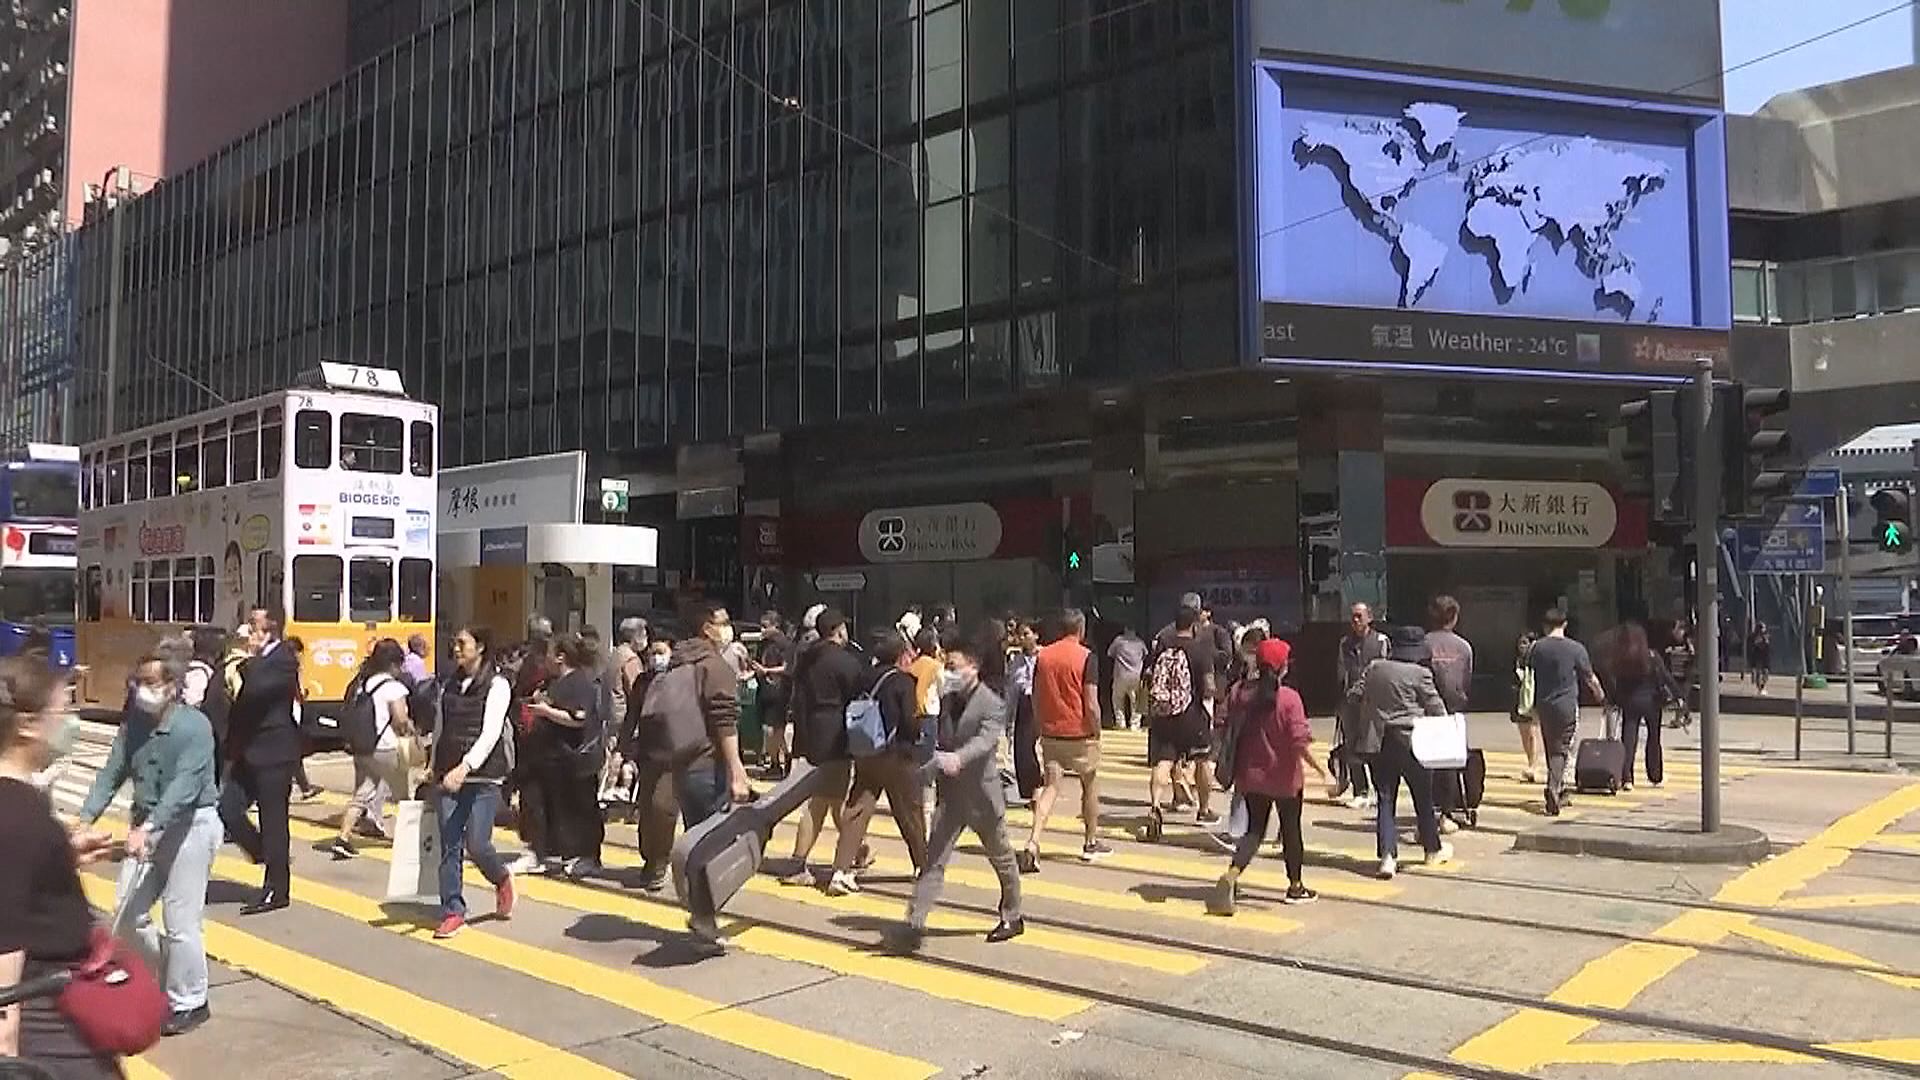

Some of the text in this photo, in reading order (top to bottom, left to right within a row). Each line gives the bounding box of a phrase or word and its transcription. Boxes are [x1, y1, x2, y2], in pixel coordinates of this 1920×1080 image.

[347, 368, 379, 387] 78
[339, 492, 401, 506] BIOGESIC
[1499, 491, 1590, 516] 大新銀行
